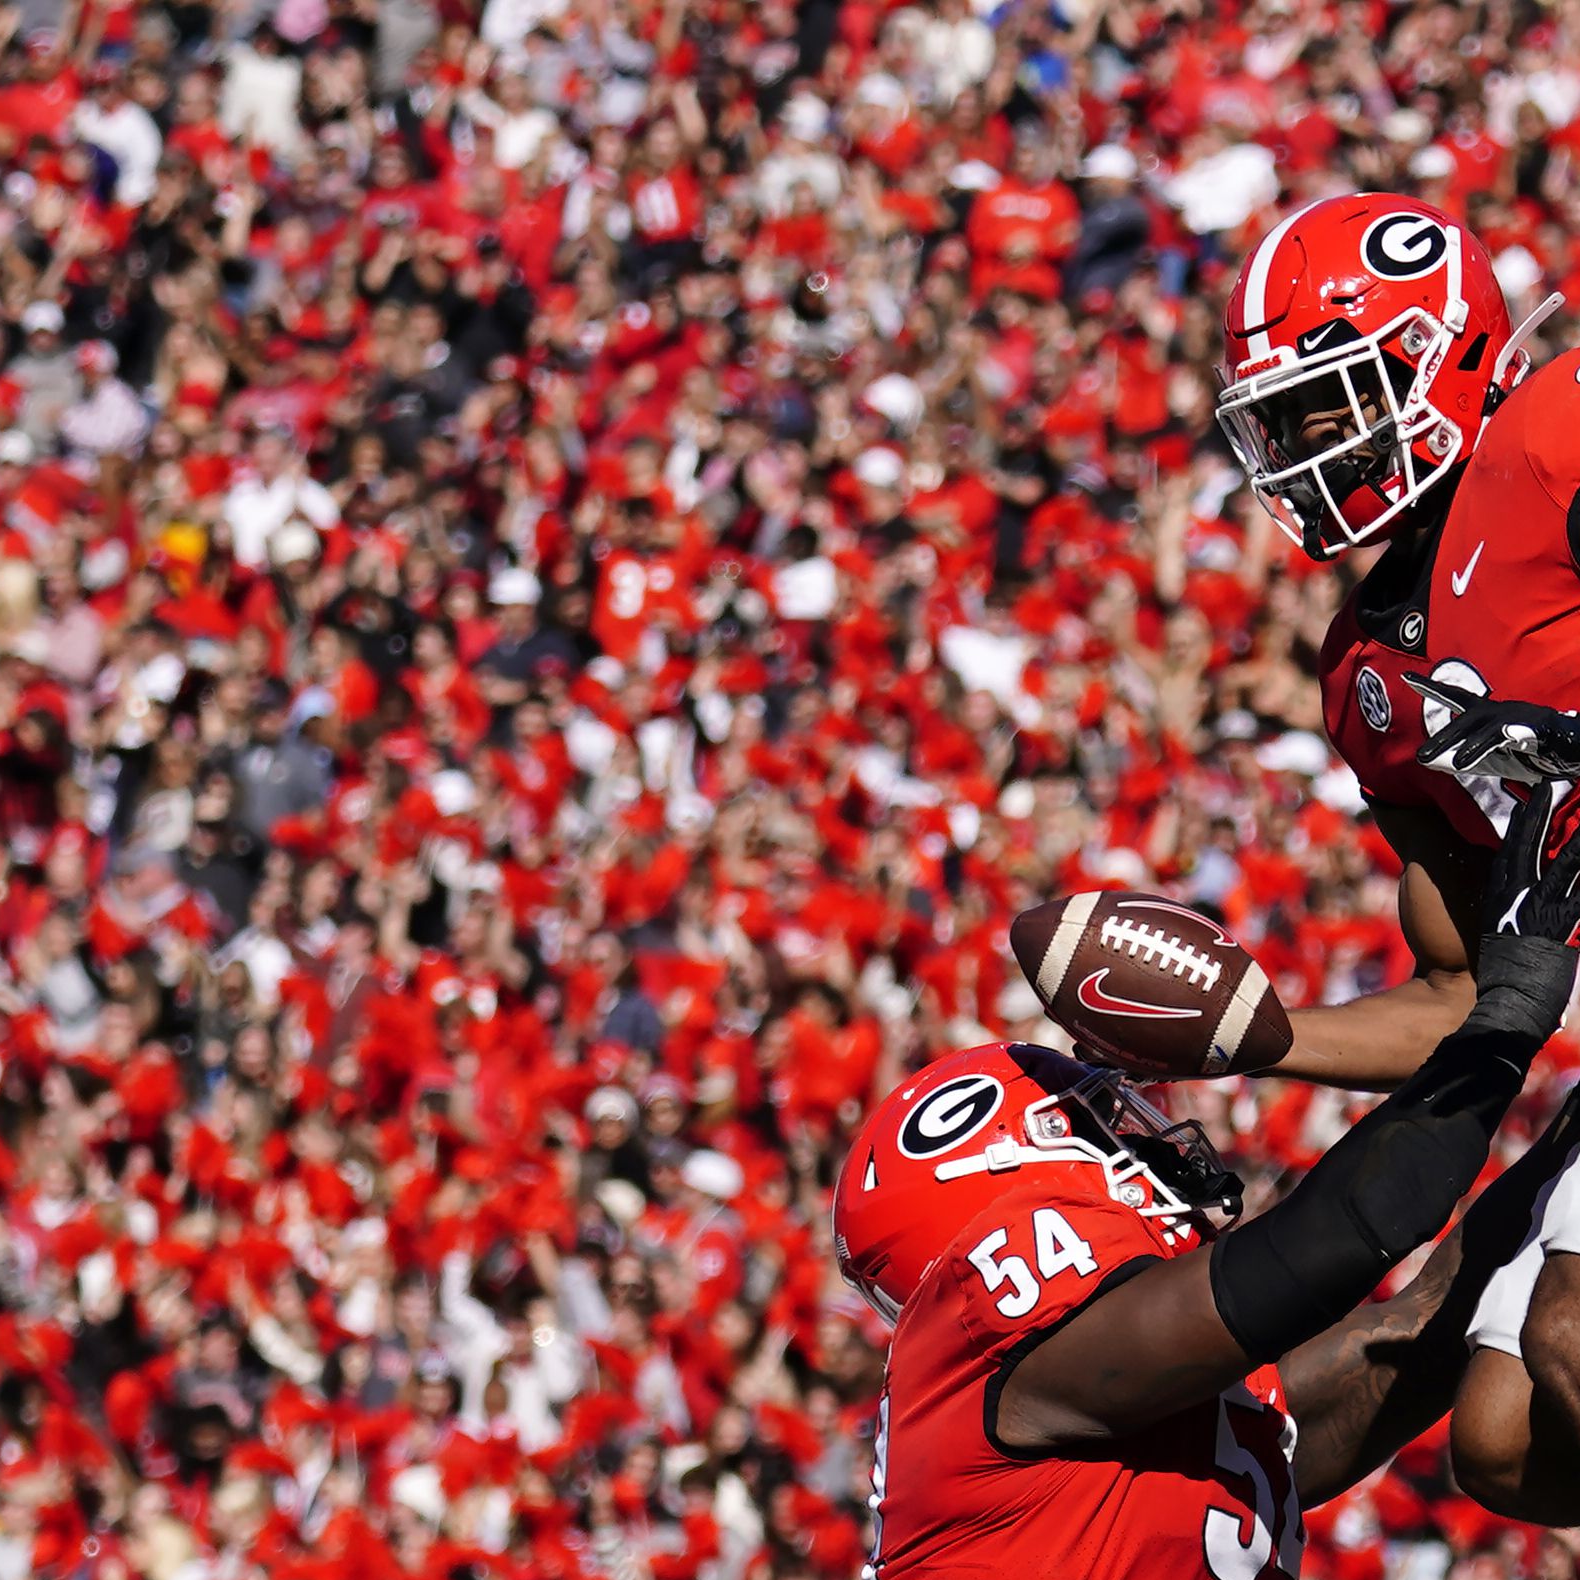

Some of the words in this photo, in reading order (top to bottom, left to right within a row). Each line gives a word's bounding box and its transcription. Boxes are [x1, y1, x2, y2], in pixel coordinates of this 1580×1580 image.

[1360, 212, 1447, 280] G
[1399, 612, 1425, 648] G
[898, 1074, 1005, 1160] G
[966, 1208, 1099, 1319] 54
